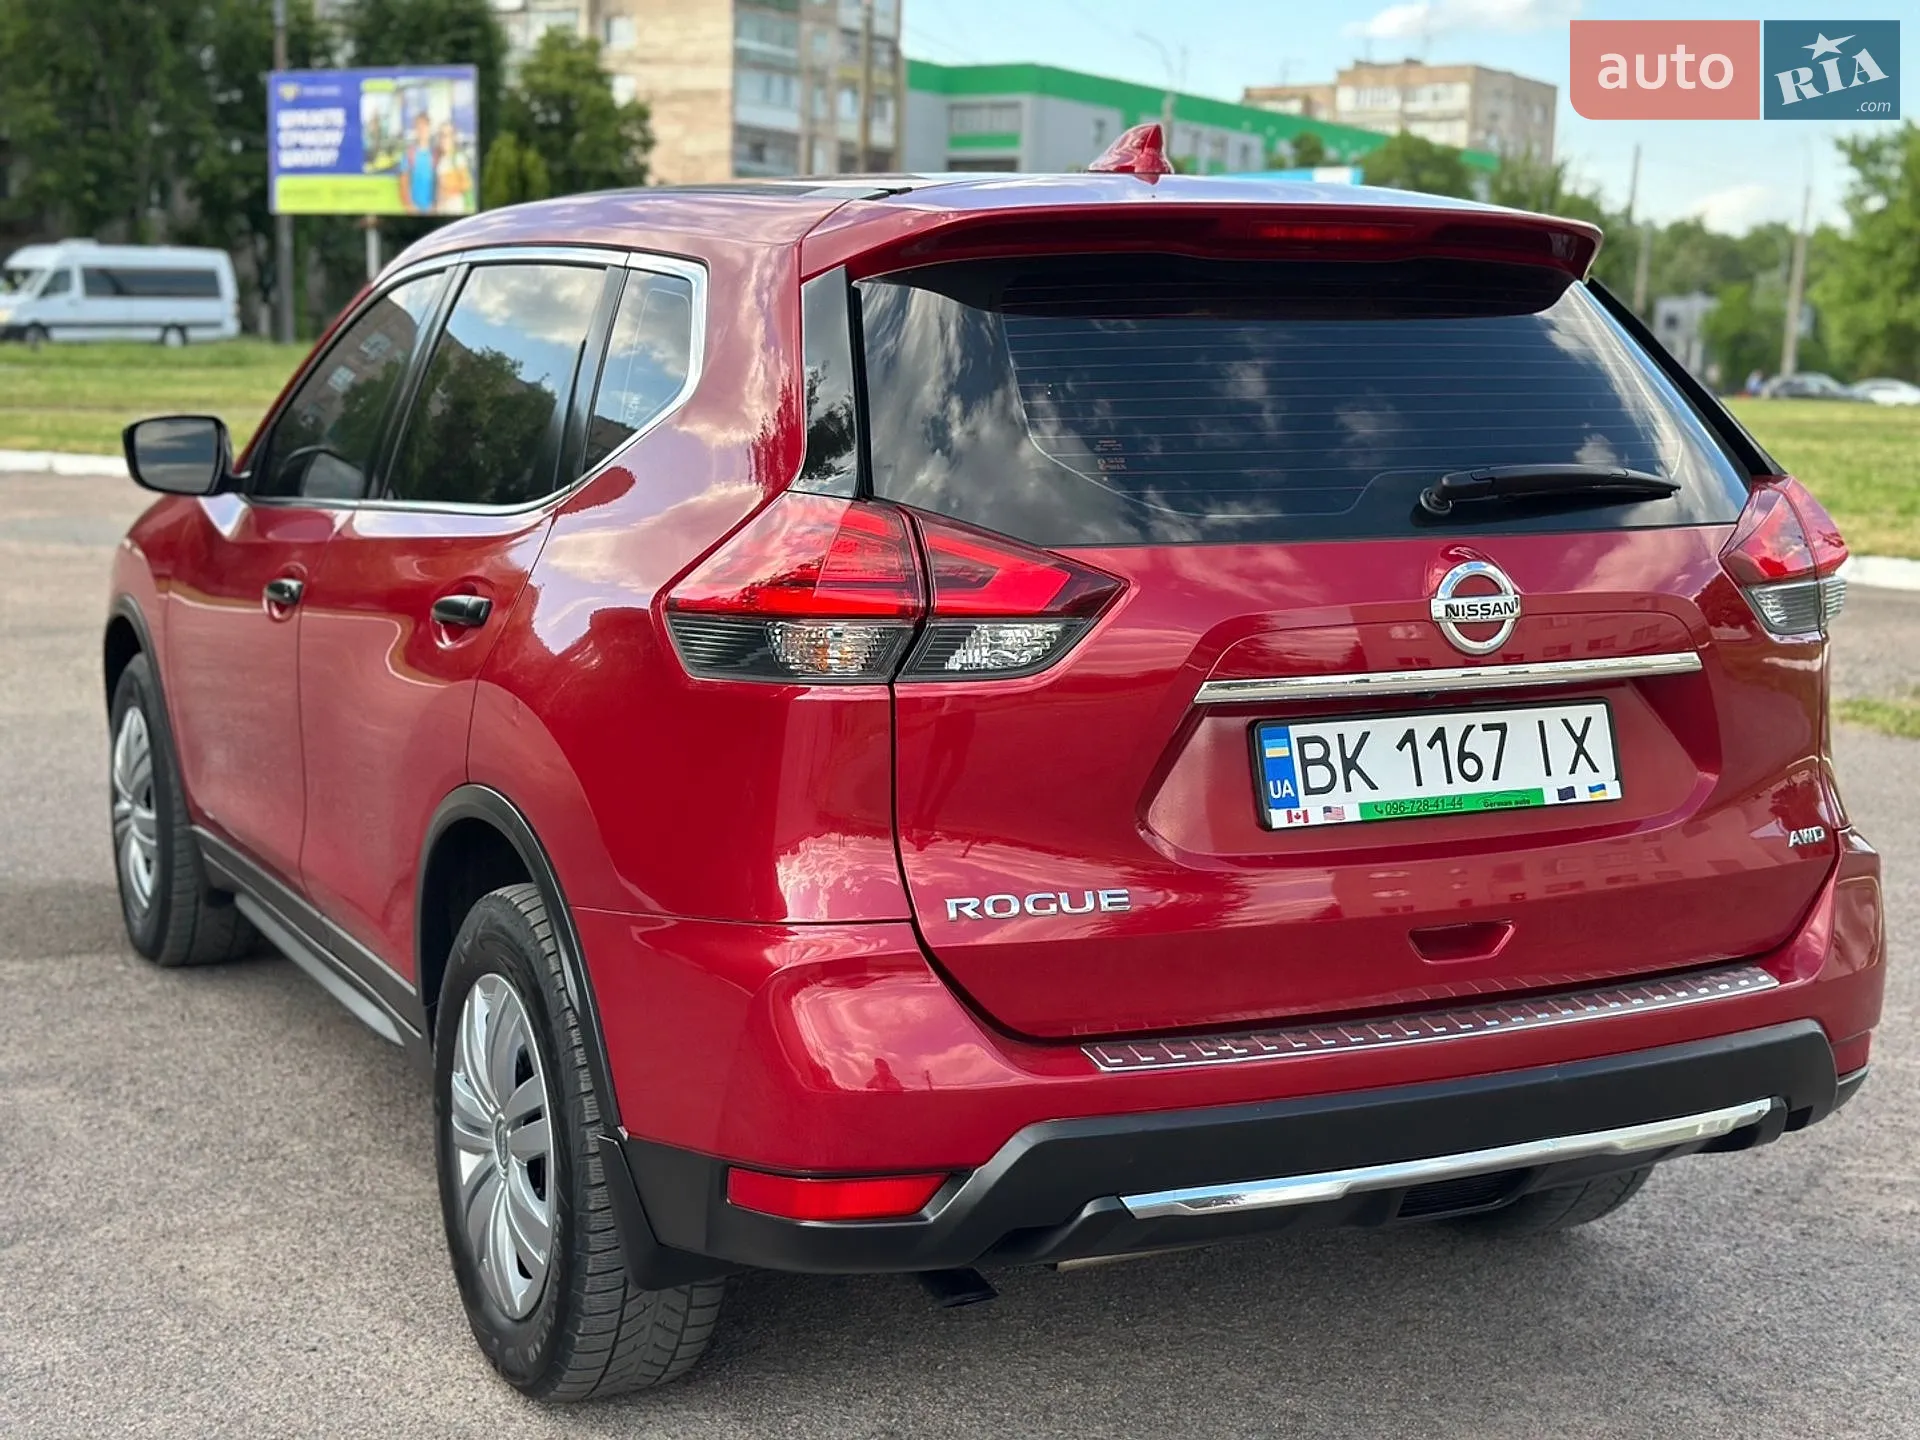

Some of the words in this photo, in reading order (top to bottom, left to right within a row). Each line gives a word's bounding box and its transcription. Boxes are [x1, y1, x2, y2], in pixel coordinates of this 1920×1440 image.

[1445, 601, 1515, 617] NISSAN
[1296, 731, 1379, 797] BK
[1396, 722, 1508, 787] 1167
[1537, 717, 1599, 777] IX
[1269, 780, 1295, 799] UA
[1384, 796, 1464, 816] 096-728-41-44
[1483, 799, 1513, 809] German
[1788, 826, 1825, 847] AWD
[944, 888, 1131, 920] ROGUE
